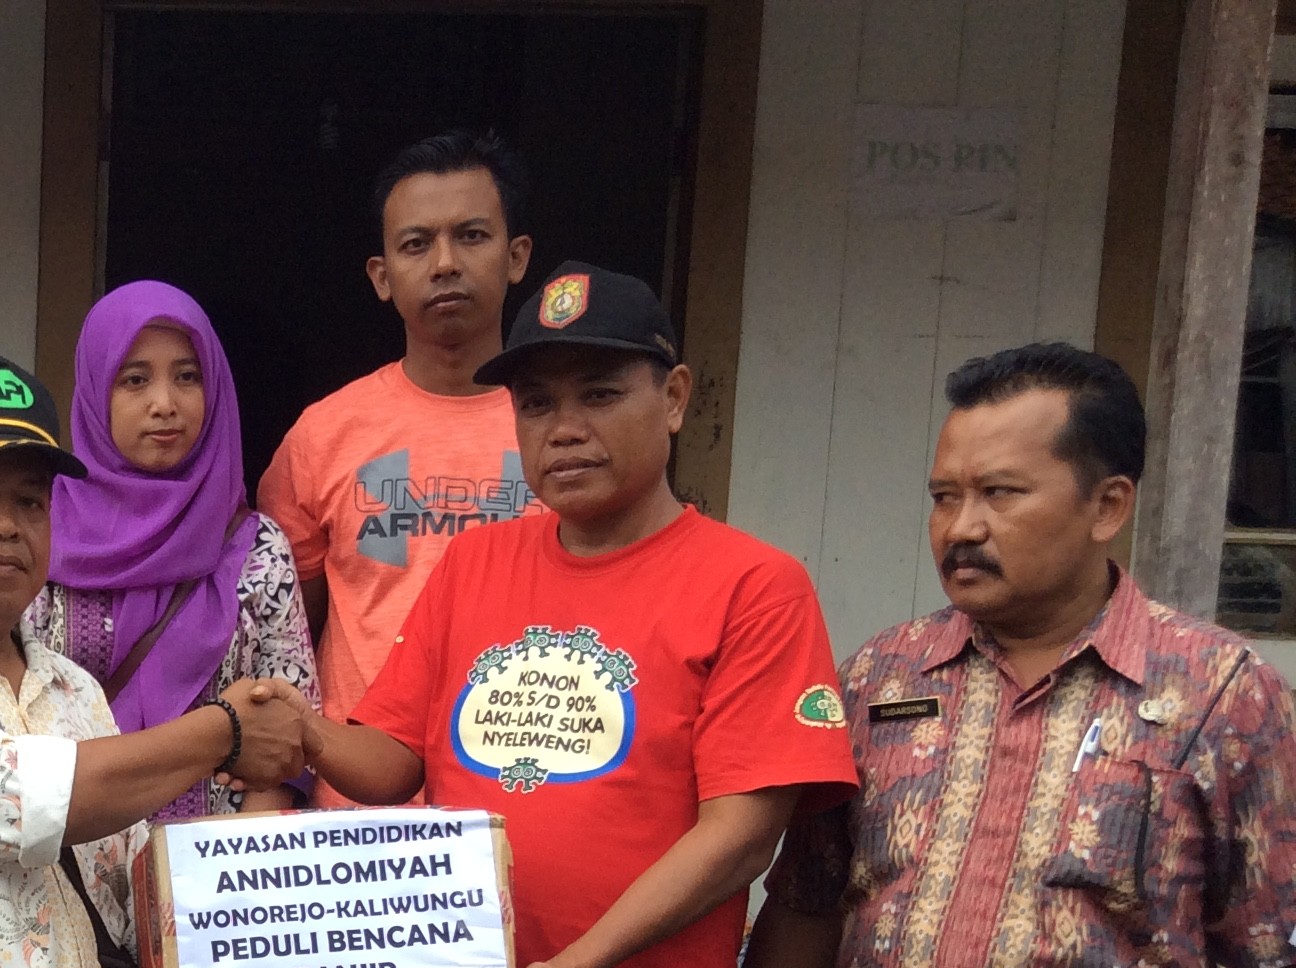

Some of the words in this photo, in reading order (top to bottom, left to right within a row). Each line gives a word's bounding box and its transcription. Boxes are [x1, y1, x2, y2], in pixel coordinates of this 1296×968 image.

[866, 140, 942, 172] POS
[356, 511, 519, 541] ARMO
[517, 669, 580, 692] KONON
[488, 689, 524, 708] 80%
[526, 692, 561, 710] S/D
[565, 695, 597, 713] 90%
[880, 705, 928, 717] SUDARSONO
[474, 709, 555, 730] LAKI-LAKI
[559, 716, 605, 734] SUKA
[482, 730, 591, 755] NYELEWENG!
[194, 831, 306, 859] YAYASAN
[313, 820, 463, 849] PENDIDIKAN
[215, 853, 453, 894] ANNIDLOMIYAH
[188, 888, 484, 930] WONOREJO-KALIWUNGU
[210, 931, 319, 963] PEDULI
[327, 919, 474, 953] BENCANA
